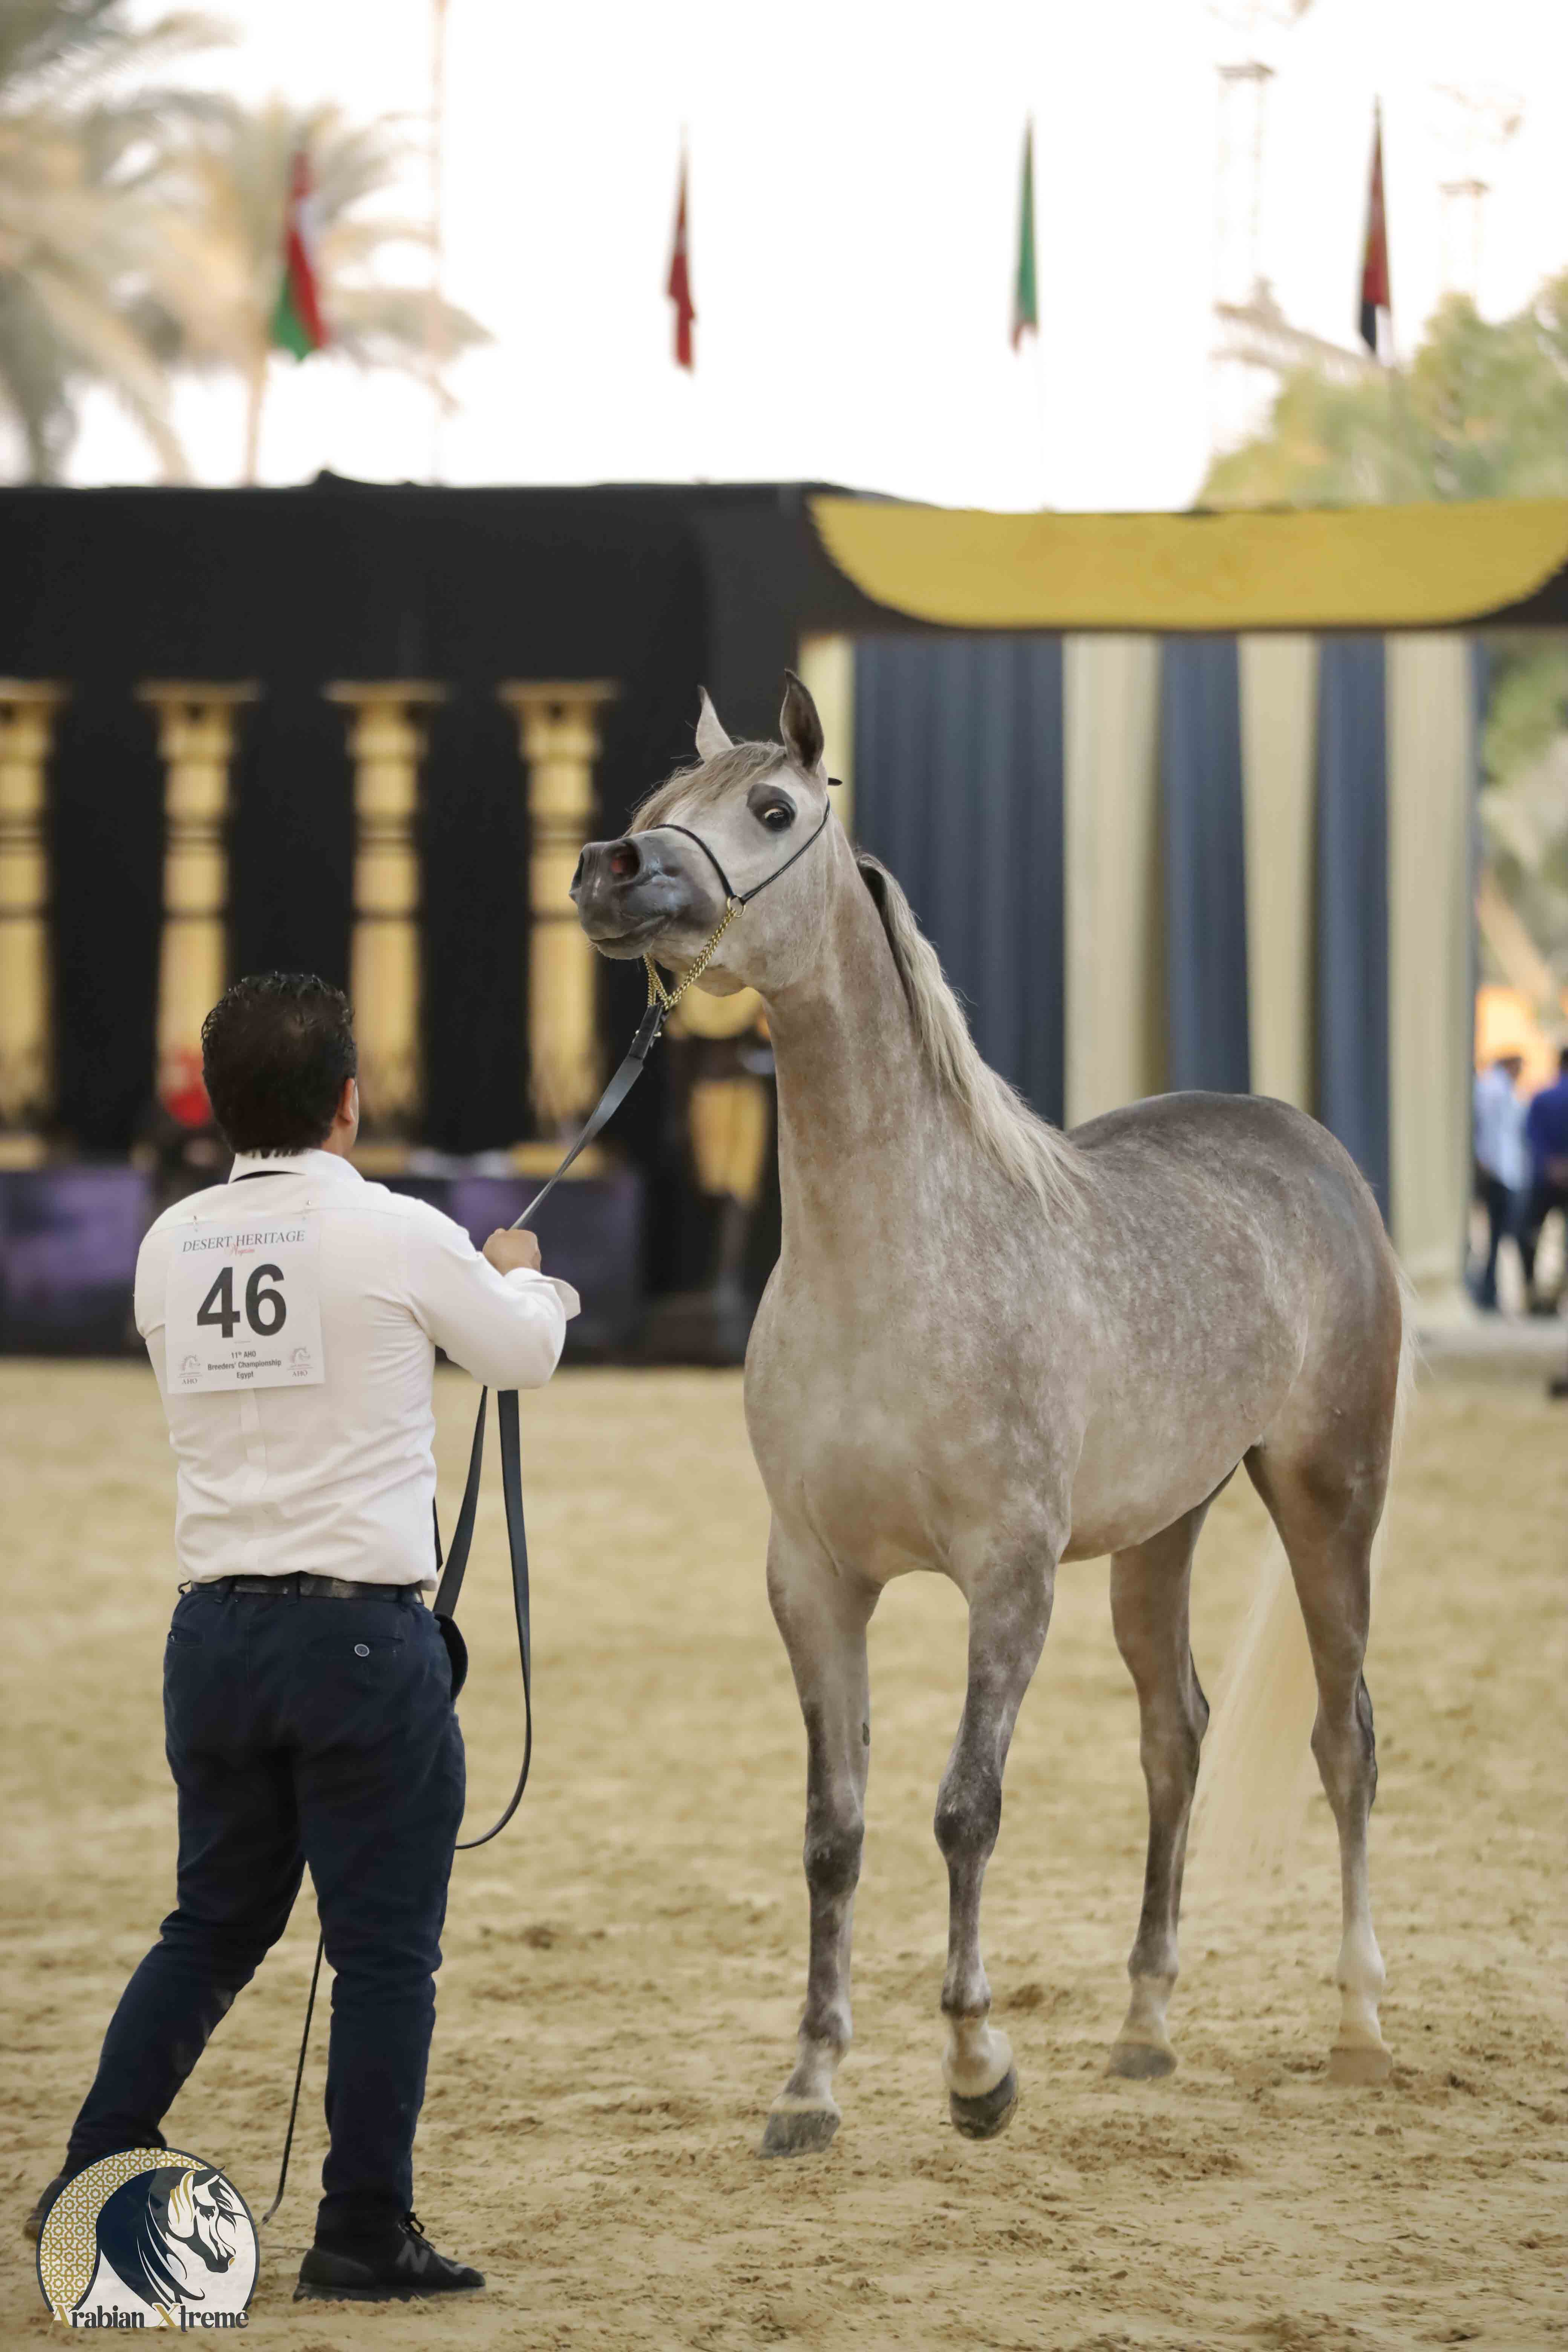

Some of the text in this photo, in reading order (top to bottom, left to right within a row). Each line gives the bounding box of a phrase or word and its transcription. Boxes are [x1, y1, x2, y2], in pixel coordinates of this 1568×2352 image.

[182, 1236, 232, 1252] DESERT
[236, 1230, 305, 1247] HERITAGE
[197, 1263, 286, 1338] 46
[238, 1359, 282, 1369] Championship
[236, 1371, 254, 1380] Egypt
